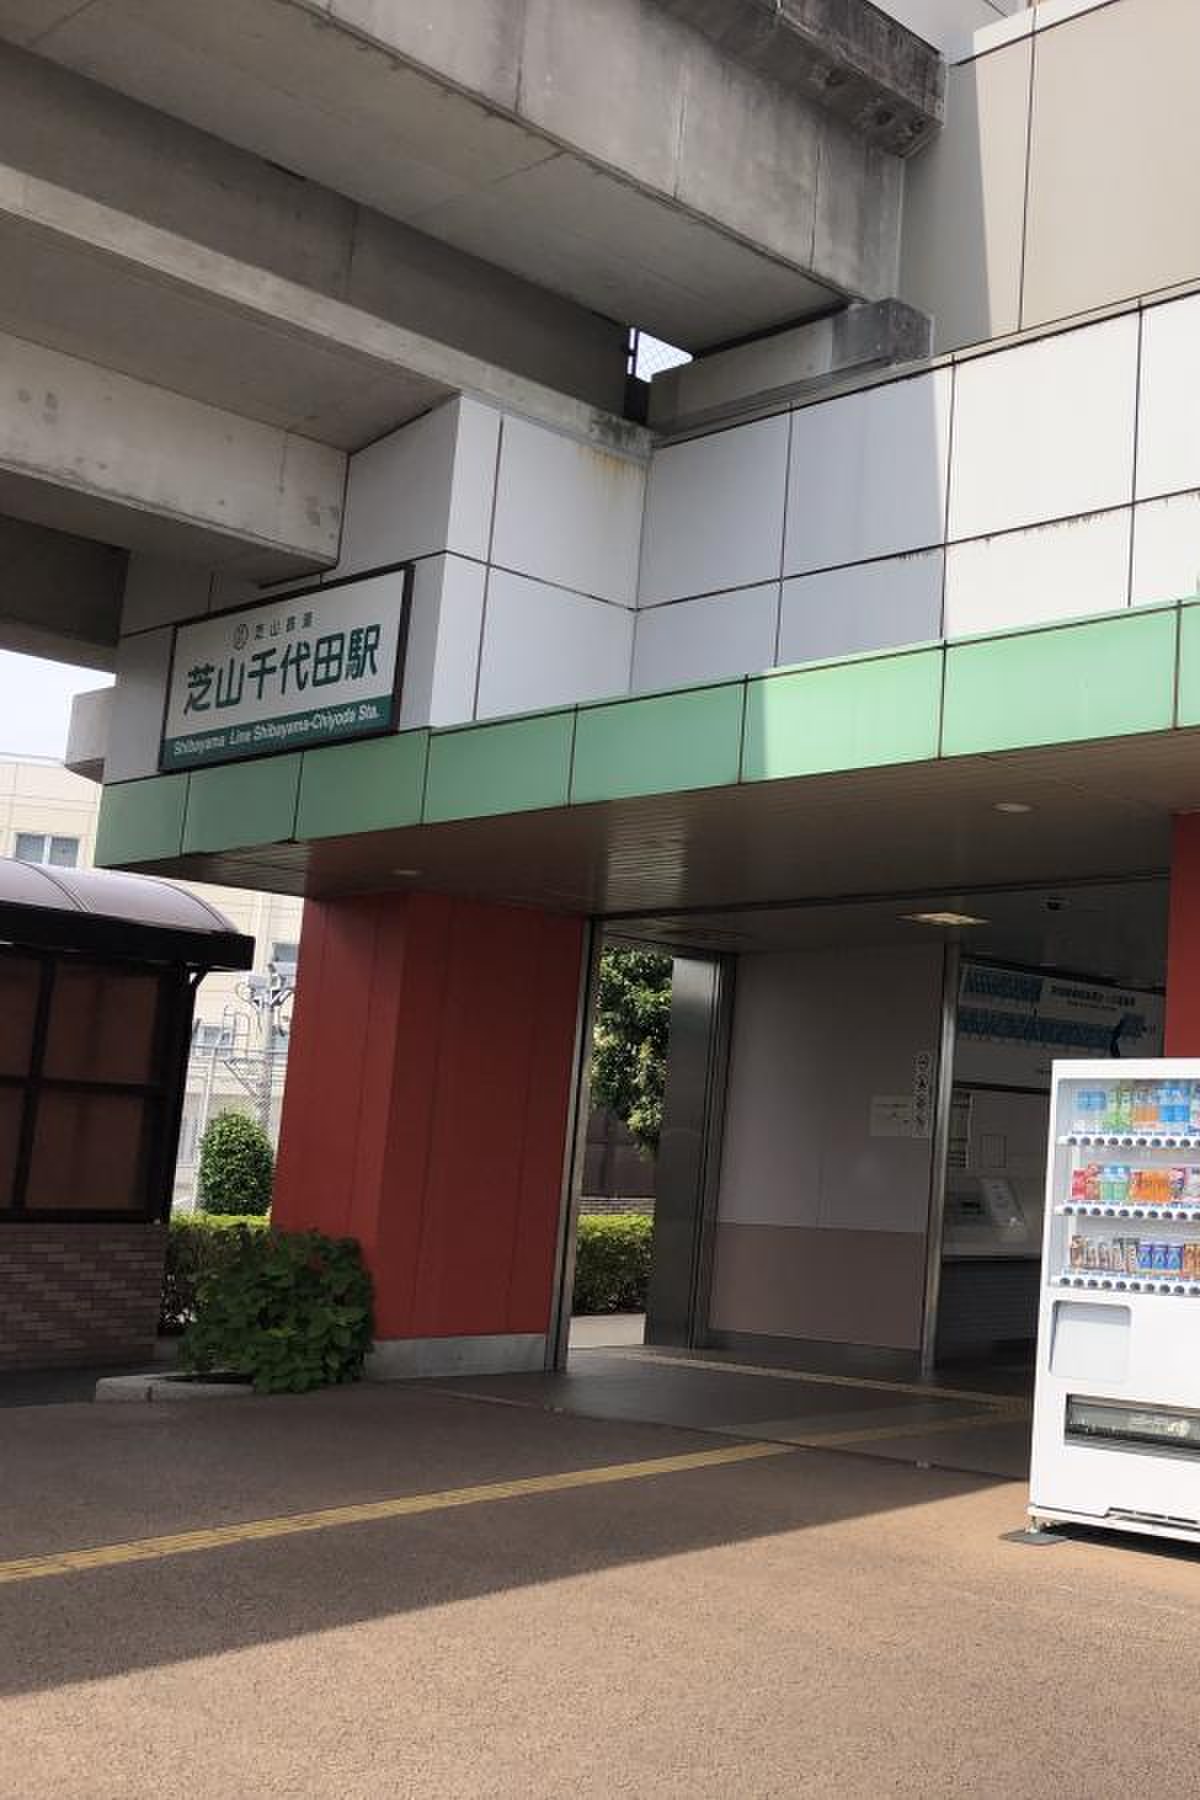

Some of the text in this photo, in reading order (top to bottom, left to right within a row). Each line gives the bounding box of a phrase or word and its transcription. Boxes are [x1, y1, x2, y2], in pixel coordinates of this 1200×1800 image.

[184, 624, 381, 715] 芝山千代田駅
[174, 736, 226, 757] Shibayama
[230, 729, 252, 746] Line
[358, 704, 380, 721] Sta.
